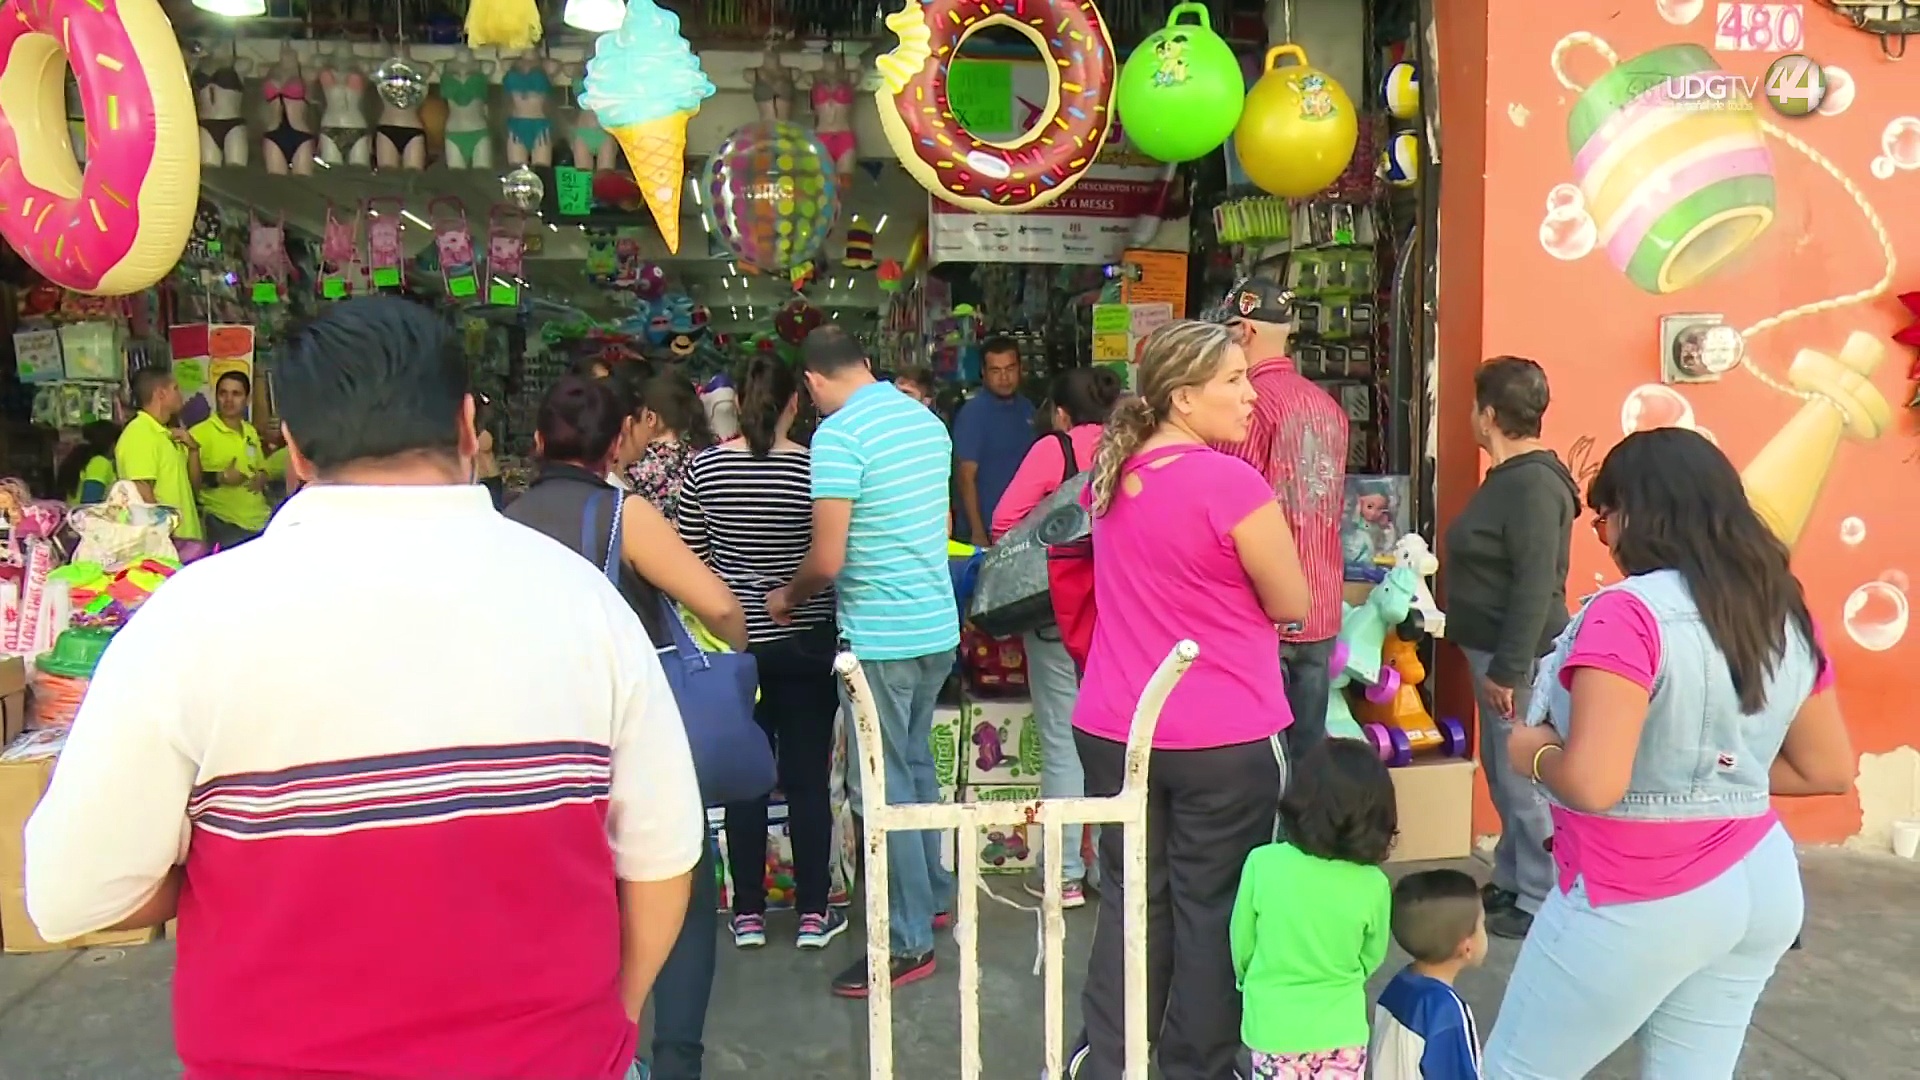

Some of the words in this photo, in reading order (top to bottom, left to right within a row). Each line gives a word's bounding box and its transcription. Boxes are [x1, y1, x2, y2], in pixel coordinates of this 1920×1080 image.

[1717, 2, 1802, 51] 480
[1061, 199, 1068, 208] Y
[1070, 199, 1077, 208] 6
[1079, 199, 1115, 210] MESES
